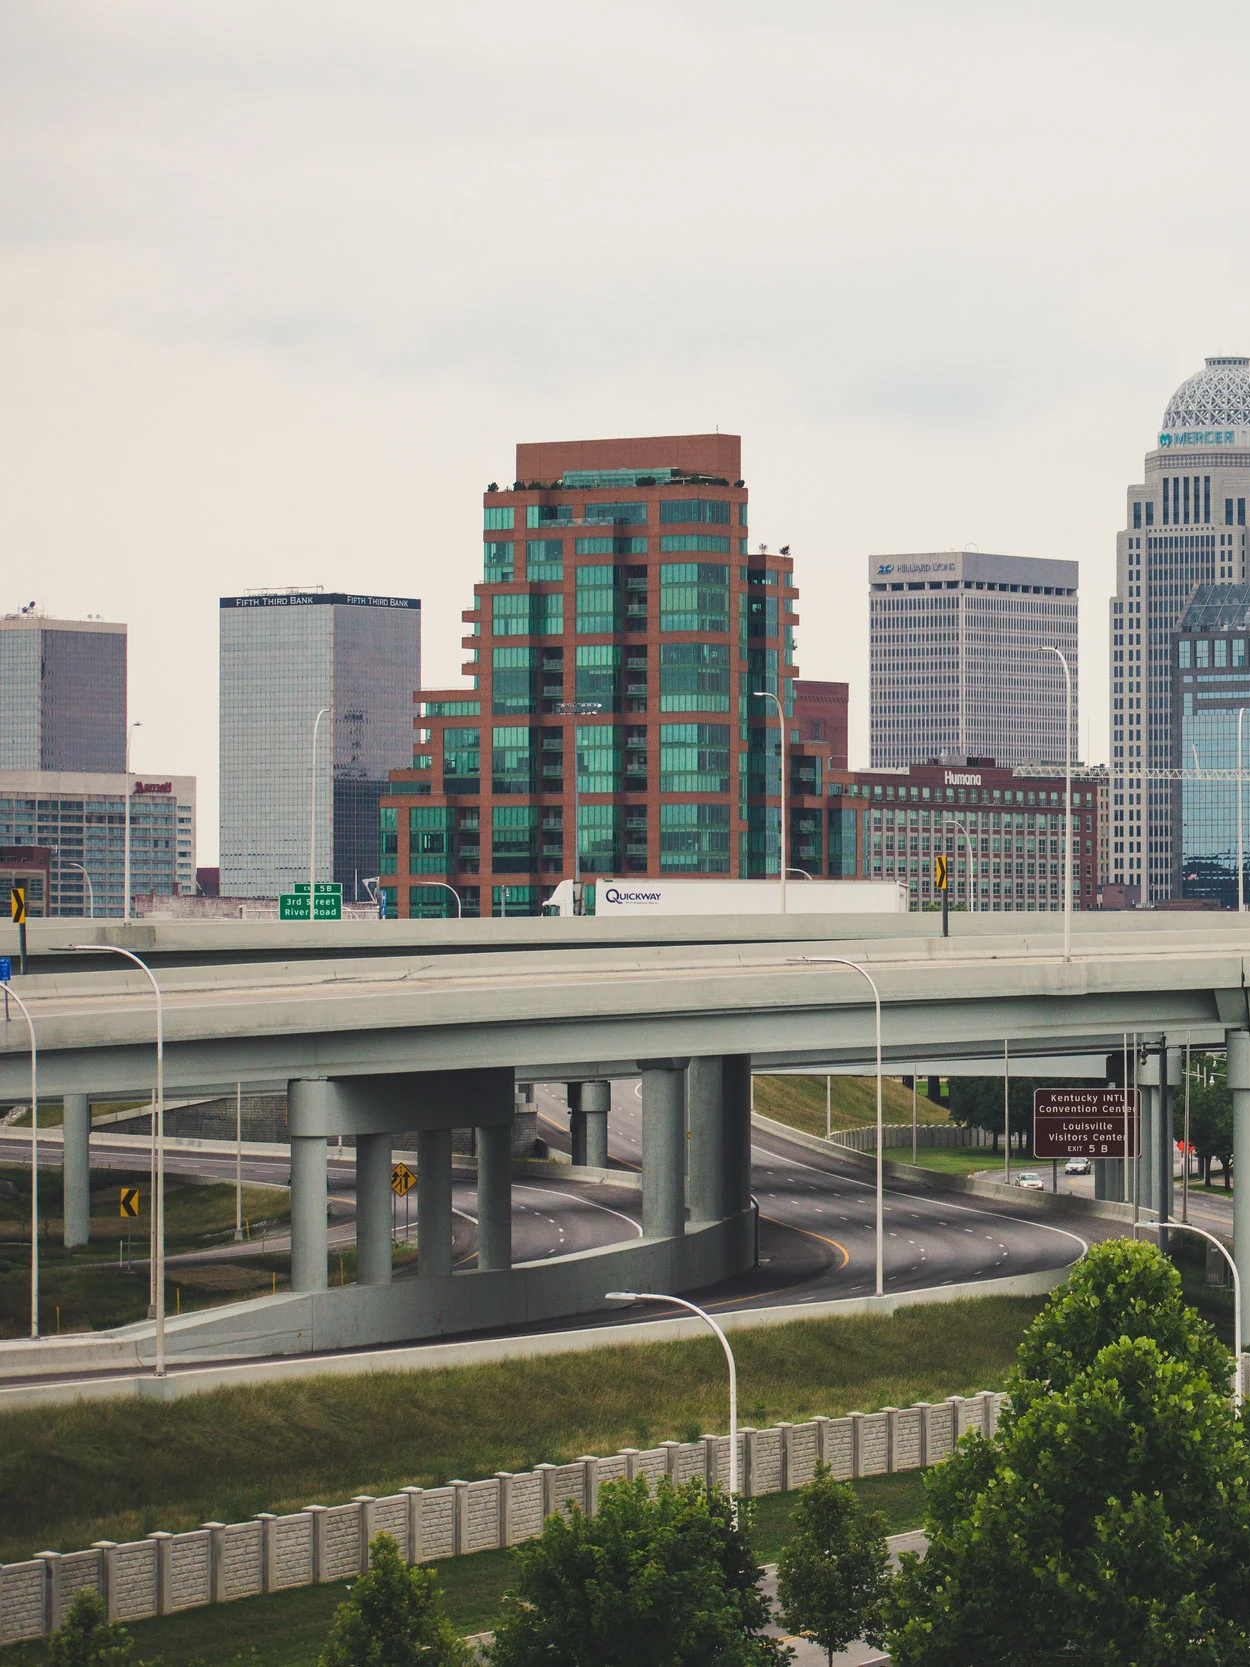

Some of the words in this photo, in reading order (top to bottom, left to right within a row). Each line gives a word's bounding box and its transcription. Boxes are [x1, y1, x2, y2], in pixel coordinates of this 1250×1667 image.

[1174, 430, 1234, 446] MERCER
[236, 598, 260, 607] FIFTH
[262, 597, 288, 606] THIRD
[289, 596, 314, 605] BANK
[346, 595, 367, 605] FIFTH
[368, 597, 389, 606] THIRD
[389, 598, 409, 608] BANK
[944, 770, 982, 786] Humana
[286, 898, 302, 906] 3rd
[284, 908, 309, 916] River
[313, 908, 337, 916] Road
[1050, 1094, 1098, 1104] Kentucky
[1103, 1094, 1125, 1102] INTL
[1039, 1104, 1098, 1113] Convention
[1062, 1122, 1113, 1131] Louisville
[1048, 1132, 1088, 1142] Visitors
[1088, 1144, 1096, 1153] 5
[1101, 1144, 1108, 1153] B
